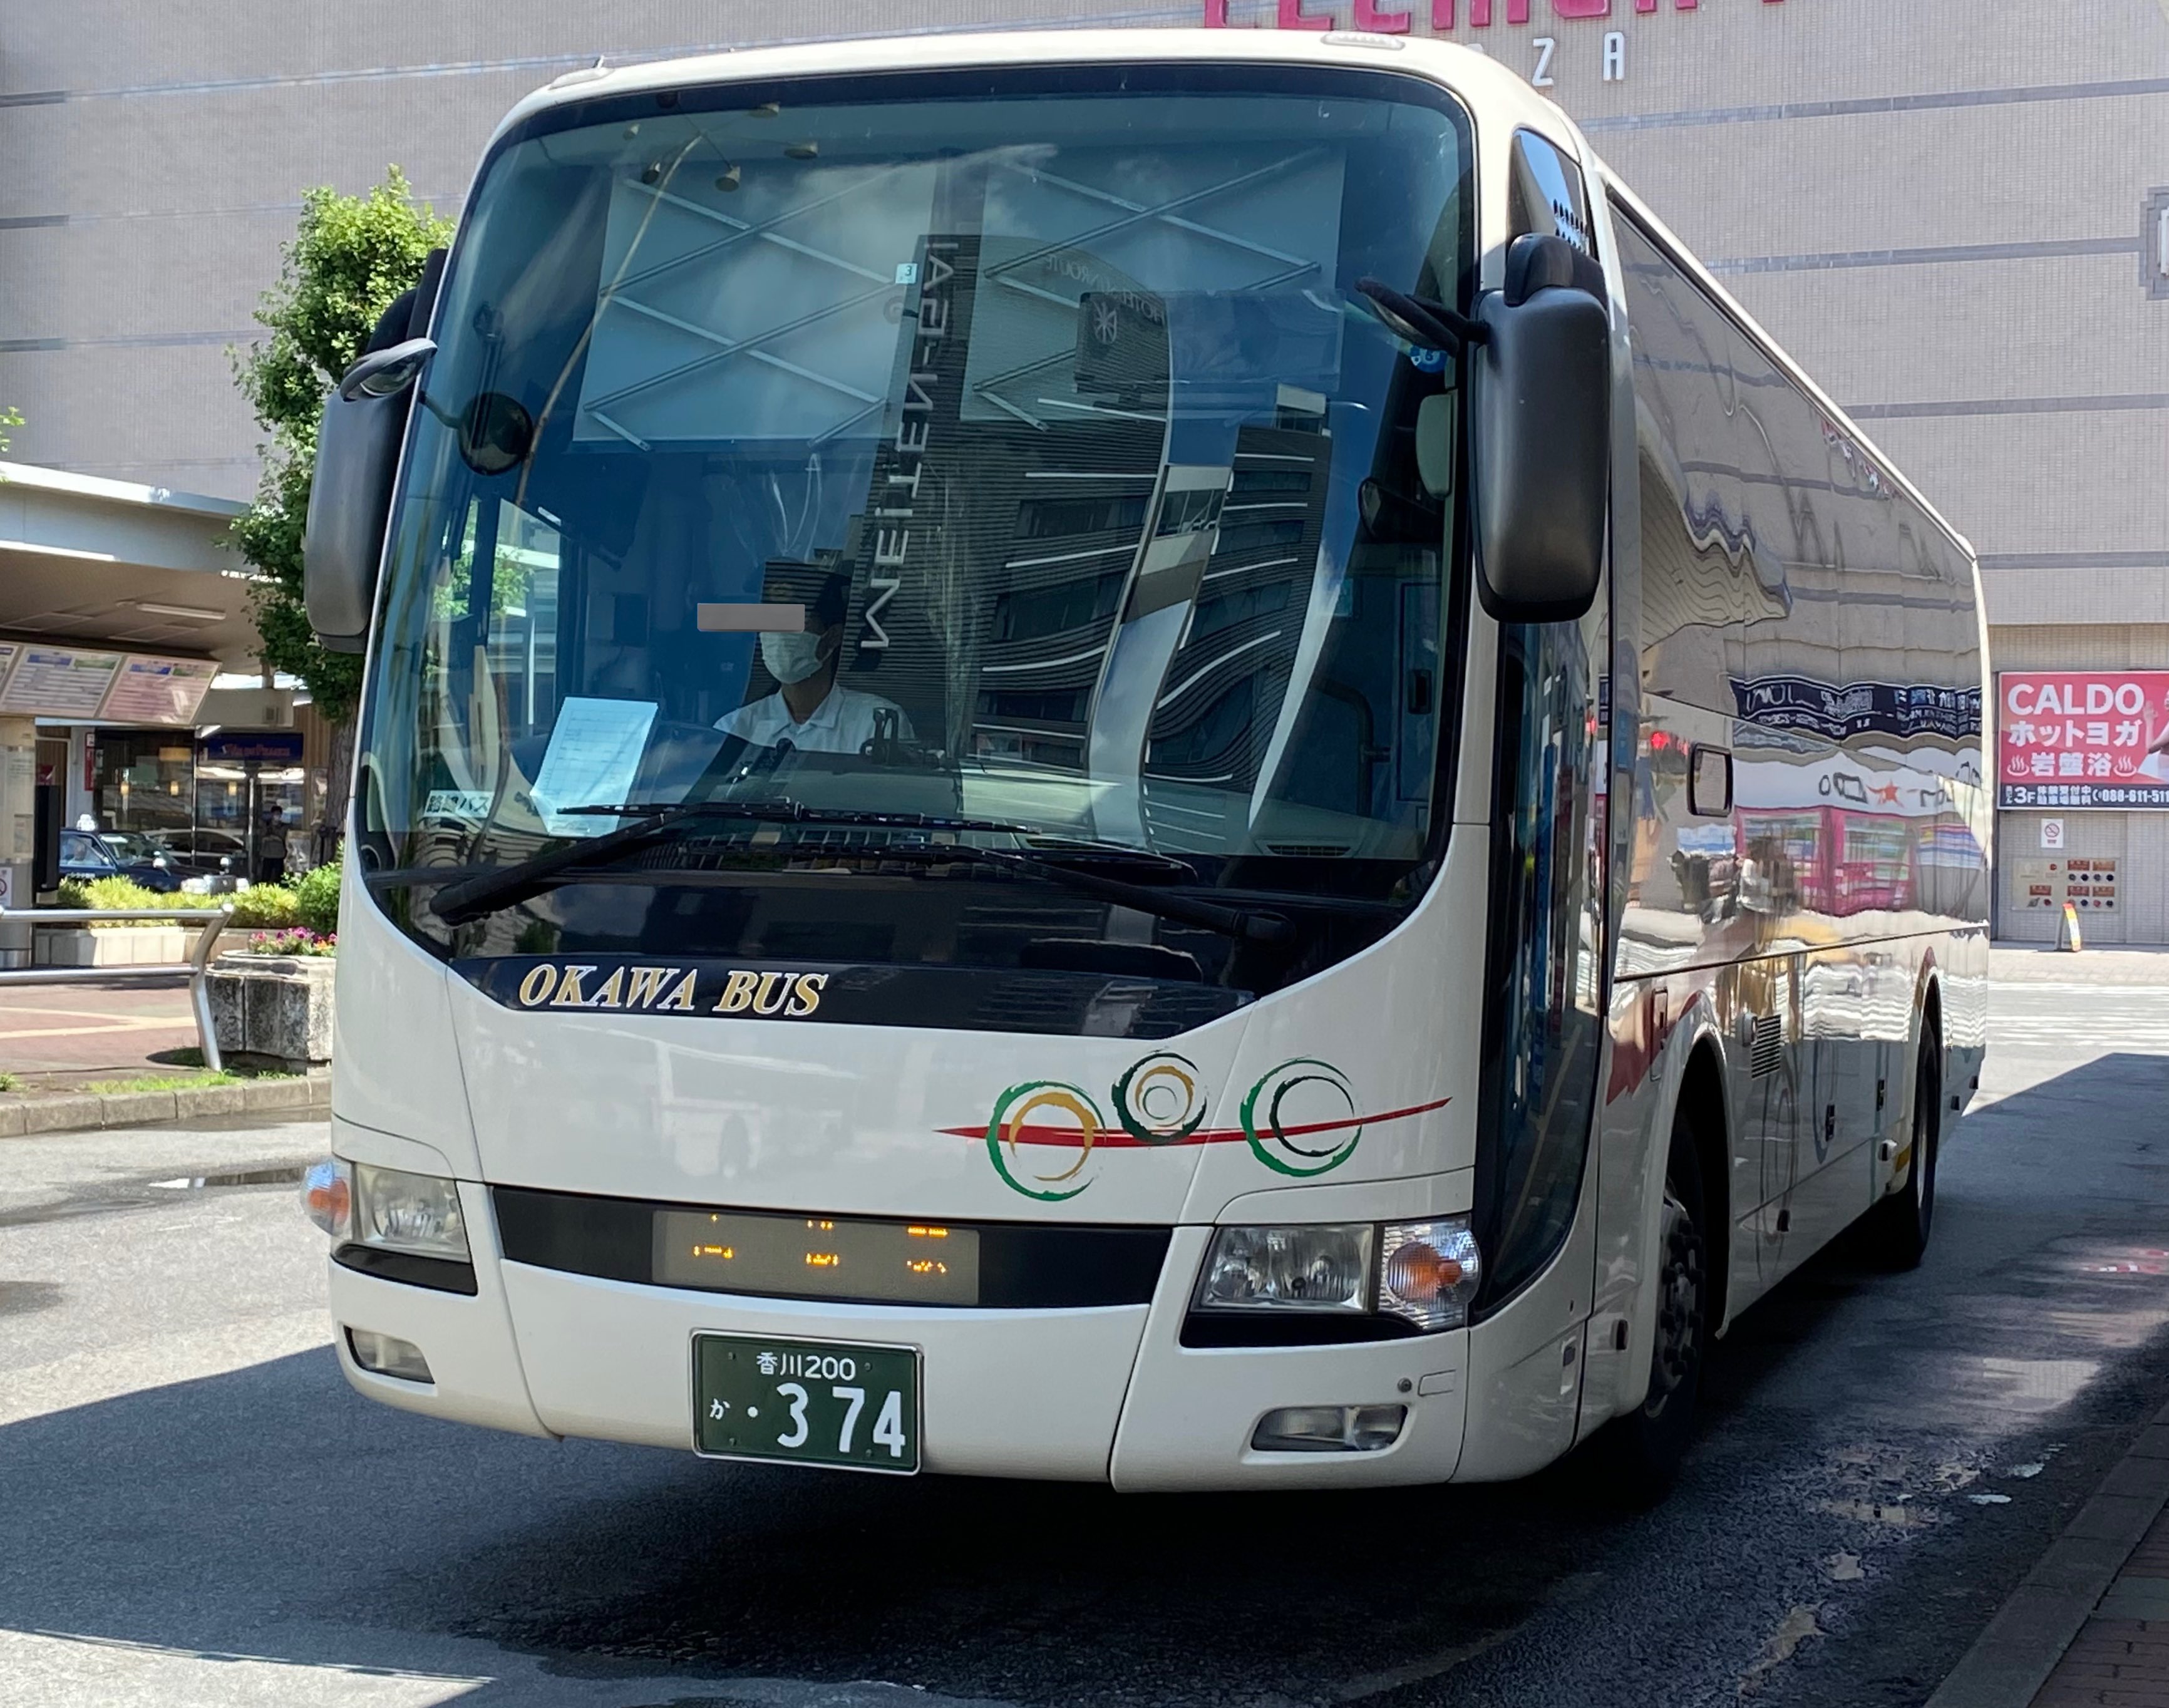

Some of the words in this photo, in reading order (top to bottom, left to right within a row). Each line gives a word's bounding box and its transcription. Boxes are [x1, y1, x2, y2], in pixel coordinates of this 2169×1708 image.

[2007, 684, 2144, 715] CALDO
[2008, 719, 2143, 747] ホットヨガ
[2031, 752, 2113, 777] 岩盤浴
[2014, 786, 2036, 803] 3F
[519, 964, 698, 1010] OKAWA
[712, 970, 830, 1016] BUS
[709, 1397, 731, 1420] か
